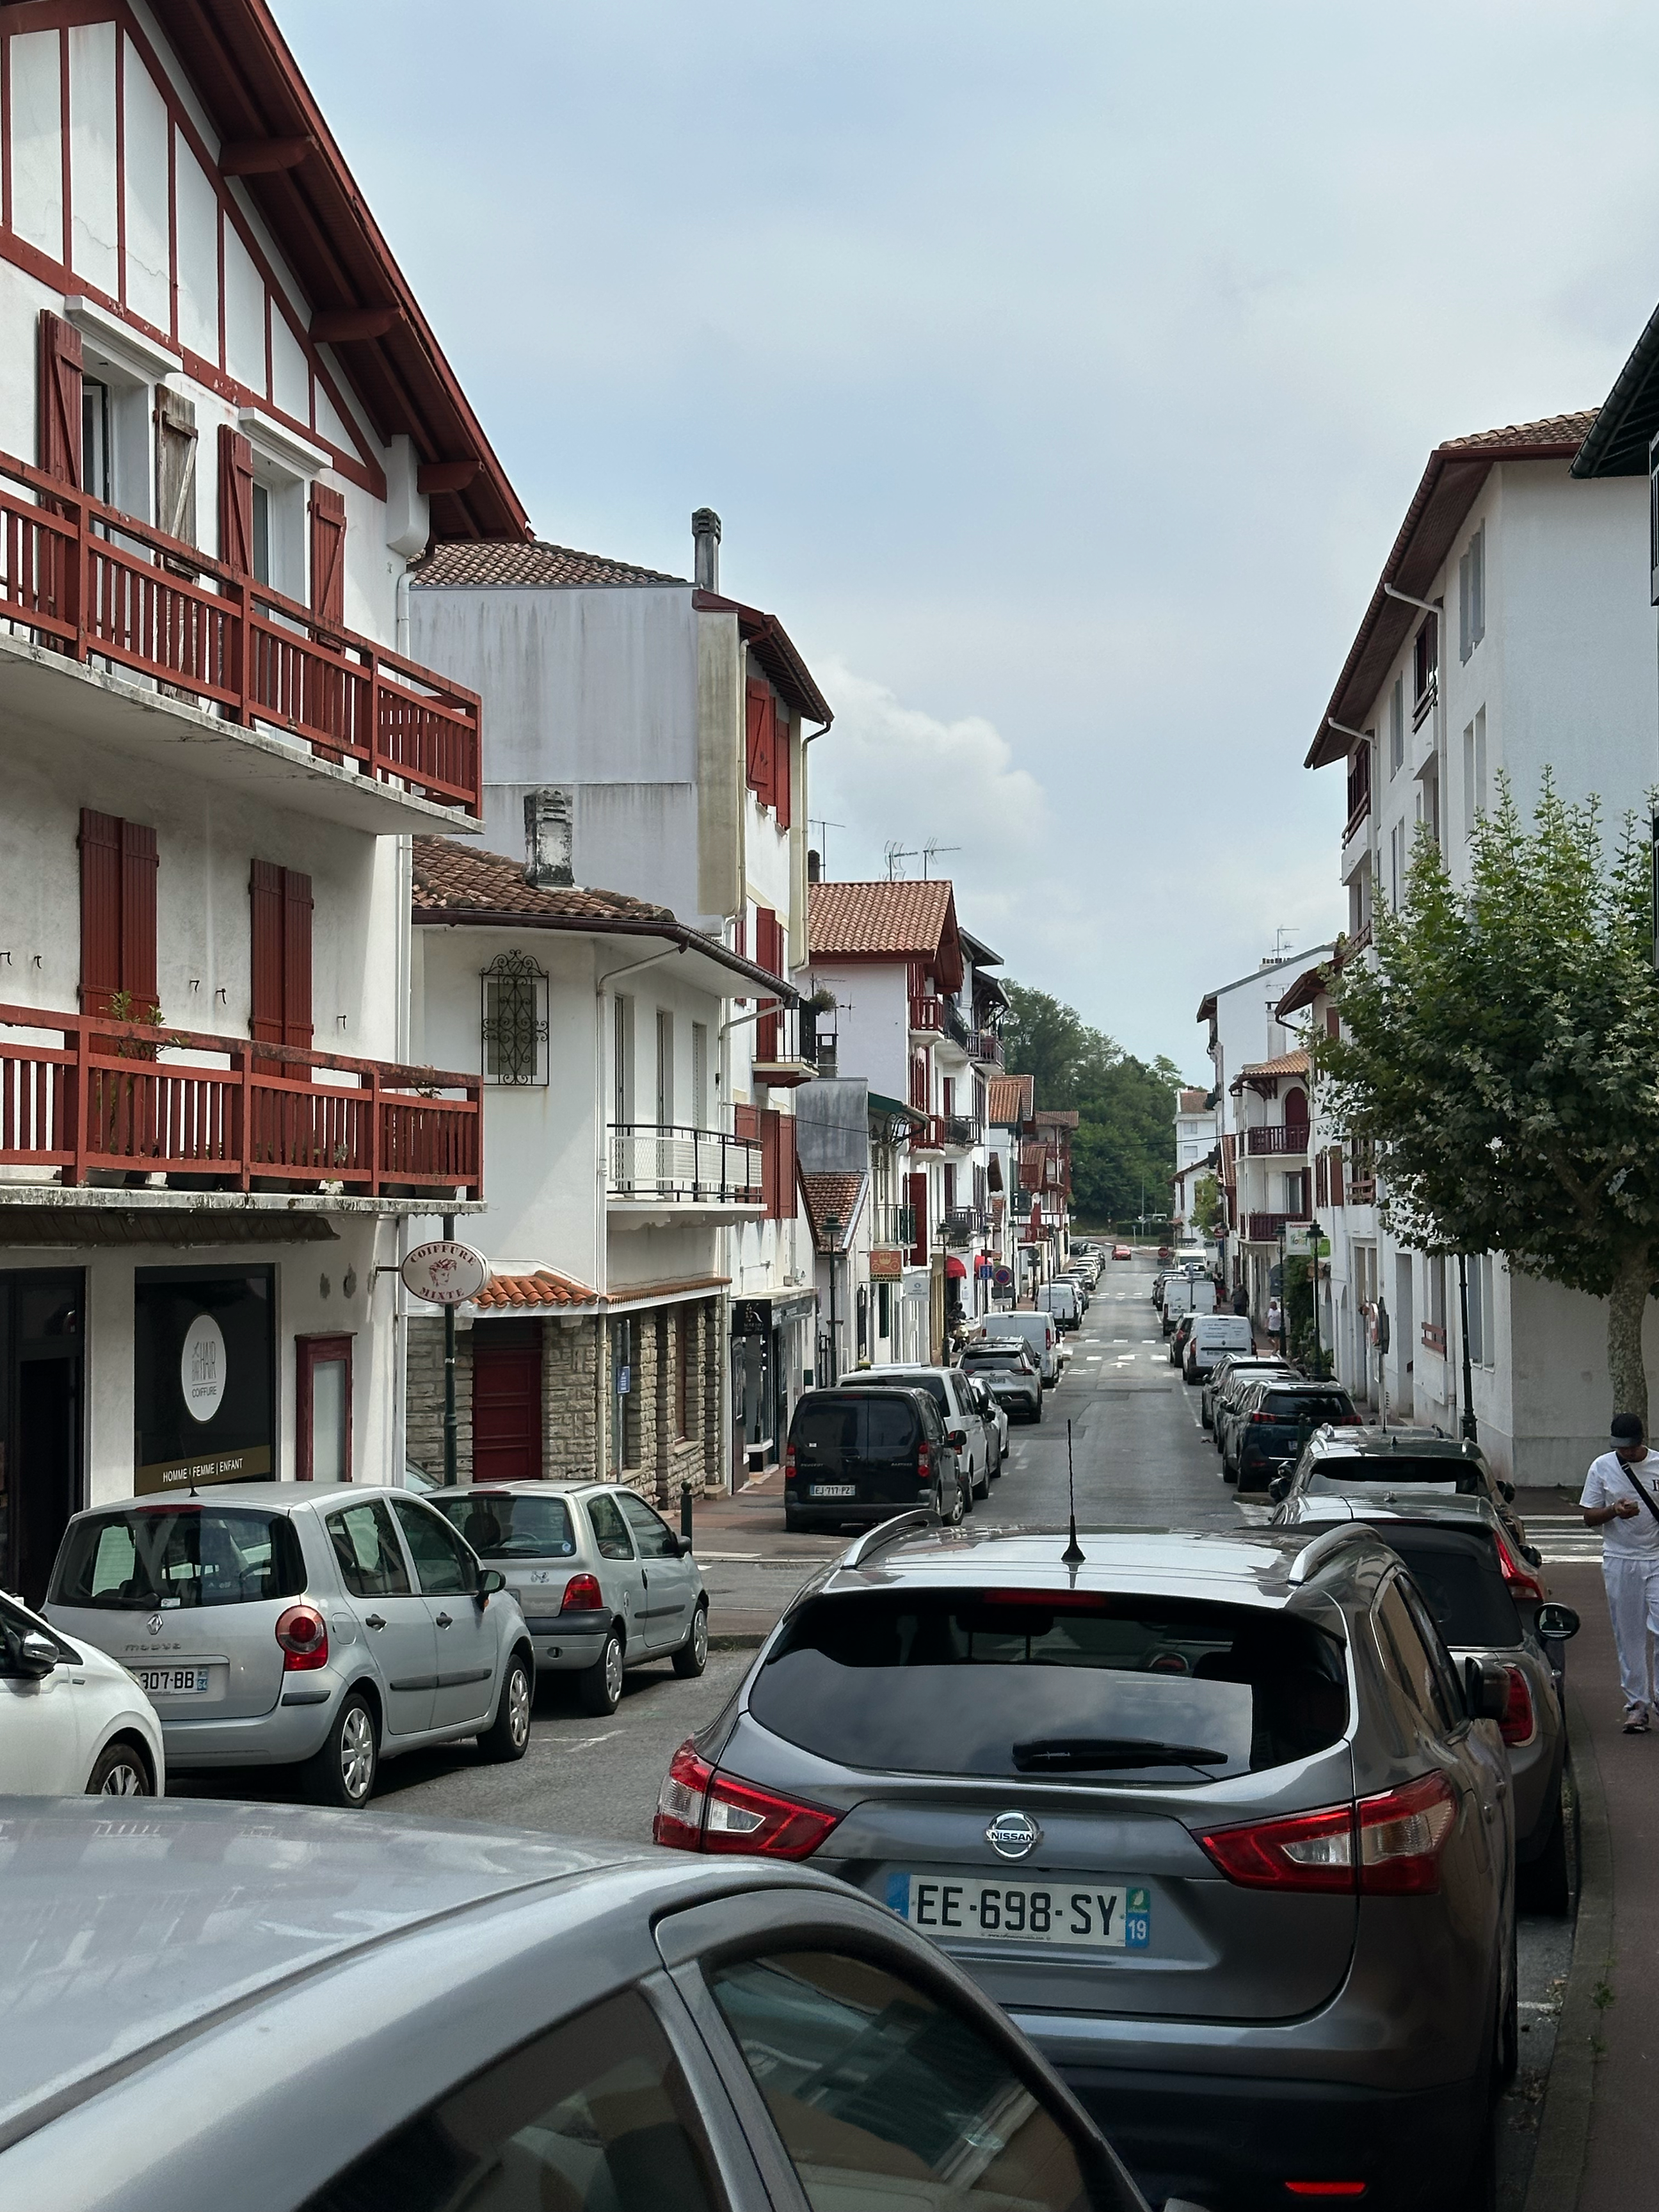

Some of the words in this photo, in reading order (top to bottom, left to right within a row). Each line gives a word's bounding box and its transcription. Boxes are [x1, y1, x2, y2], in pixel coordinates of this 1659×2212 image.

[410, 1244, 477, 1266] COIFFURE
[420, 1286, 465, 1301] MIXTE
[191, 1386, 217, 1398] COIFFURE
[163, 1468, 188, 1483] HOMME
[192, 1463, 215, 1478] FEMME
[219, 1457, 243, 1472] ENFANT
[991, 1832, 1034, 1841] NISSAN
[917, 1884, 1118, 1936] EE-698-SY
[1128, 1919, 1147, 1940] 19
